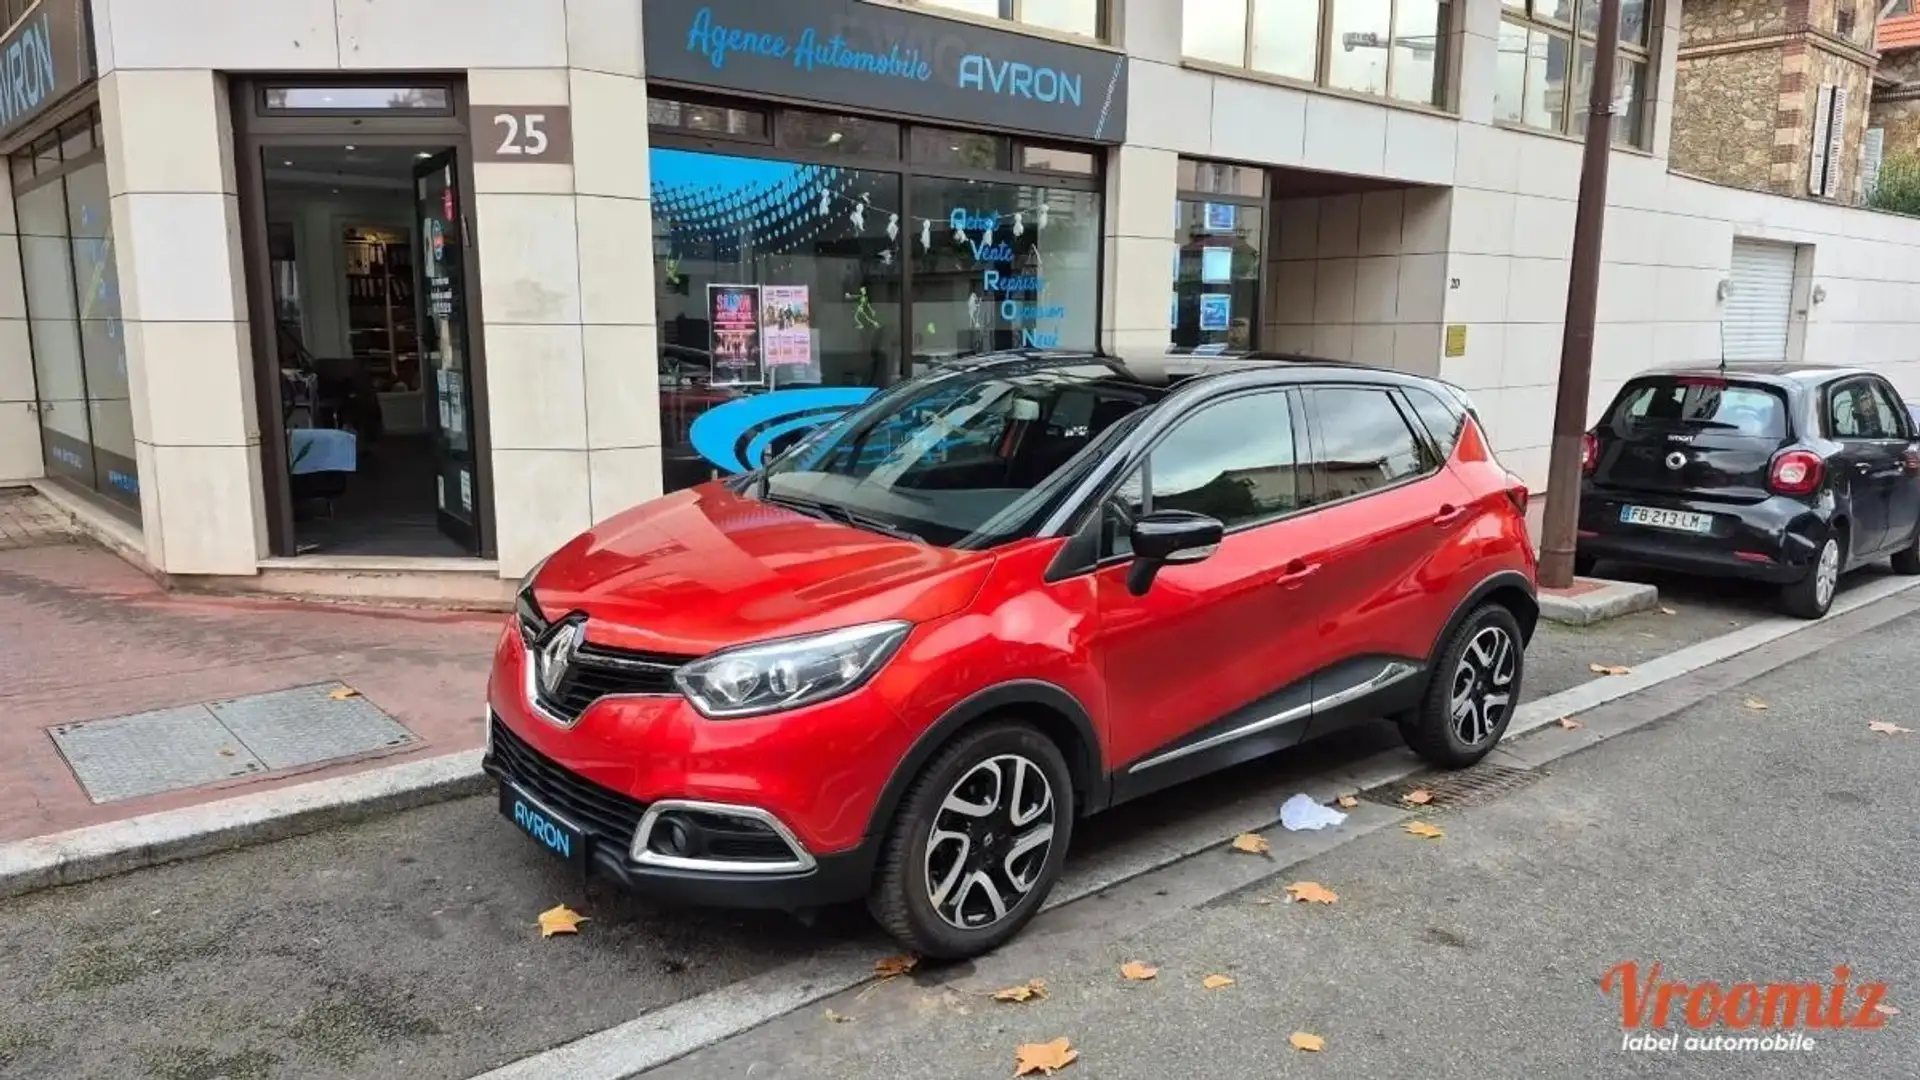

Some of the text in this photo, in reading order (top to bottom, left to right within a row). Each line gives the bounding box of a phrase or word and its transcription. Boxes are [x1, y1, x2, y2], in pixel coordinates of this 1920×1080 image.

[0, 12, 54, 127] VRON
[687, 7, 791, 68] Agence
[794, 27, 932, 81] Automobile
[959, 54, 1081, 107] AVRON
[494, 113, 548, 155] 25
[970, 239, 1014, 260] Vente
[1667, 434, 1695, 443] smart
[515, 800, 569, 857] AVRON
